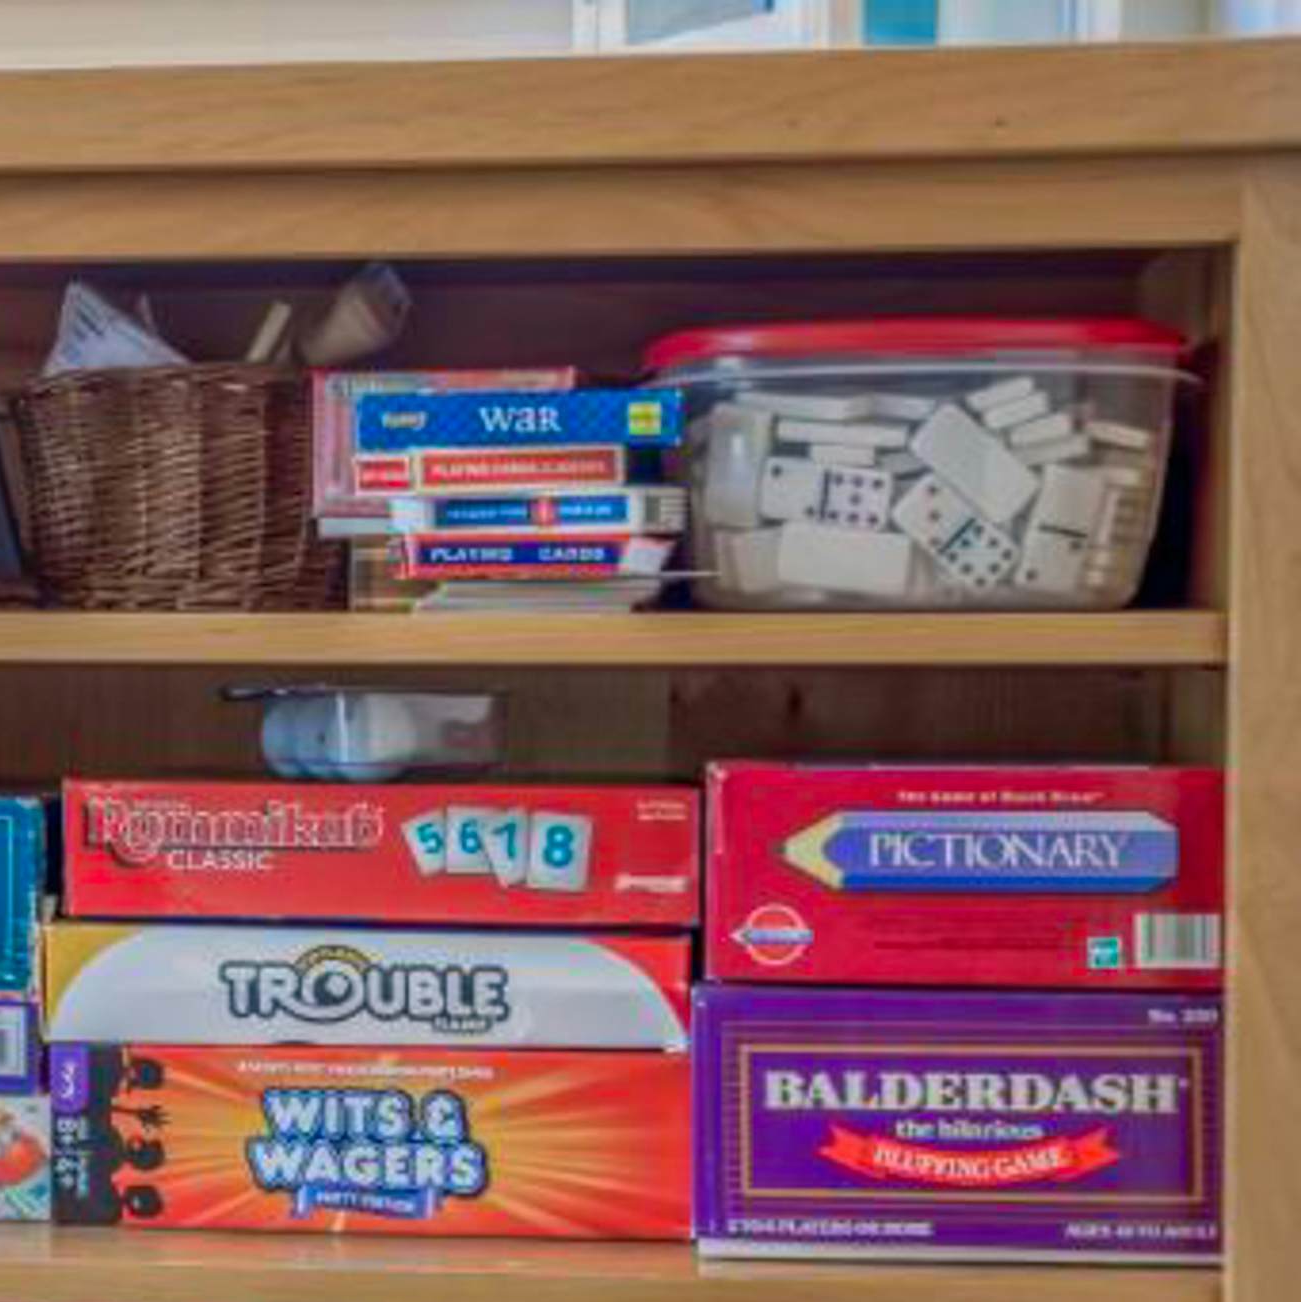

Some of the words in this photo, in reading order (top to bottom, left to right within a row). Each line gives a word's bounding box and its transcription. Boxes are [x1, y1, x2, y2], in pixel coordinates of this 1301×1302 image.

[417, 822, 443, 852] 5
[460, 818, 481, 852] 6
[543, 824, 575, 866] 8
[869, 832, 1127, 868] PICTIONARY
[167, 850, 273, 871] CLASSIC
[220, 960, 509, 1022] TROUBLE
[764, 1071, 1180, 1112] BALDERDASH
[267, 1097, 411, 1138] WITS
[425, 1096, 462, 1138] &
[938, 1120, 1043, 1139] hilarious
[254, 1143, 483, 1192] WAGERS
